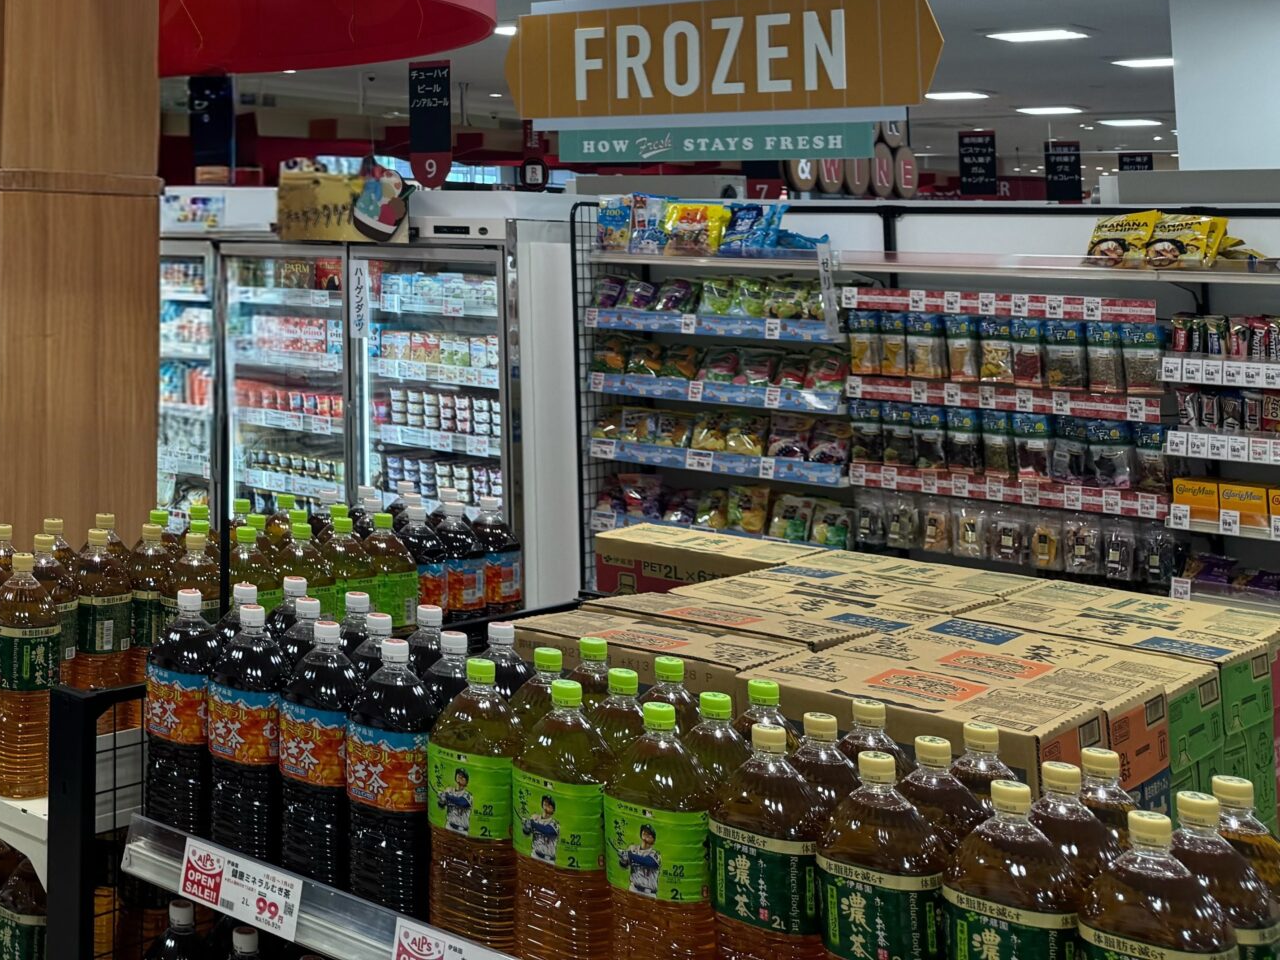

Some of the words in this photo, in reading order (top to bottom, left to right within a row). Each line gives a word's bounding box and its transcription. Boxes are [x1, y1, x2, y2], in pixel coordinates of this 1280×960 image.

[574, 9, 847, 101] FROZEN
[410, 68, 448, 79] チューハイ
[417, 84, 442, 93] ビール
[582, 140, 629, 153] HOW
[683, 136, 755, 152] STAYS
[764, 134, 843, 150] FRESH
[425, 159, 437, 178] 9
[284, 263, 310, 273] PARM
[482, 805, 493, 816] 22
[480, 826, 492, 837] 2L
[570, 835, 581, 846] 22
[716, 825, 767, 848] 体脂肪を減らす
[197, 853, 214, 868] ALPS
[568, 857, 581, 868] 2L
[187, 870, 215, 888] OPEN
[672, 865, 684, 877] 22
[790, 856, 798, 892] Reduces
[826, 861, 884, 885] 体脂肪を減らす
[185, 881, 217, 903] SALE!!
[231, 868, 292, 899] 健康ミネラルむぎ茶
[728, 855, 755, 920] 濃い茶
[241, 897, 250, 907] 2L
[670, 889, 684, 900] 2L
[792, 895, 800, 916] Body
[910, 892, 918, 930] Reduces
[956, 893, 1022, 921] 体脂肪を減らす
[772, 916, 786, 930] 2L
[410, 936, 432, 952] ALPS
[1093, 931, 1166, 960] 体脂肪を減らす
